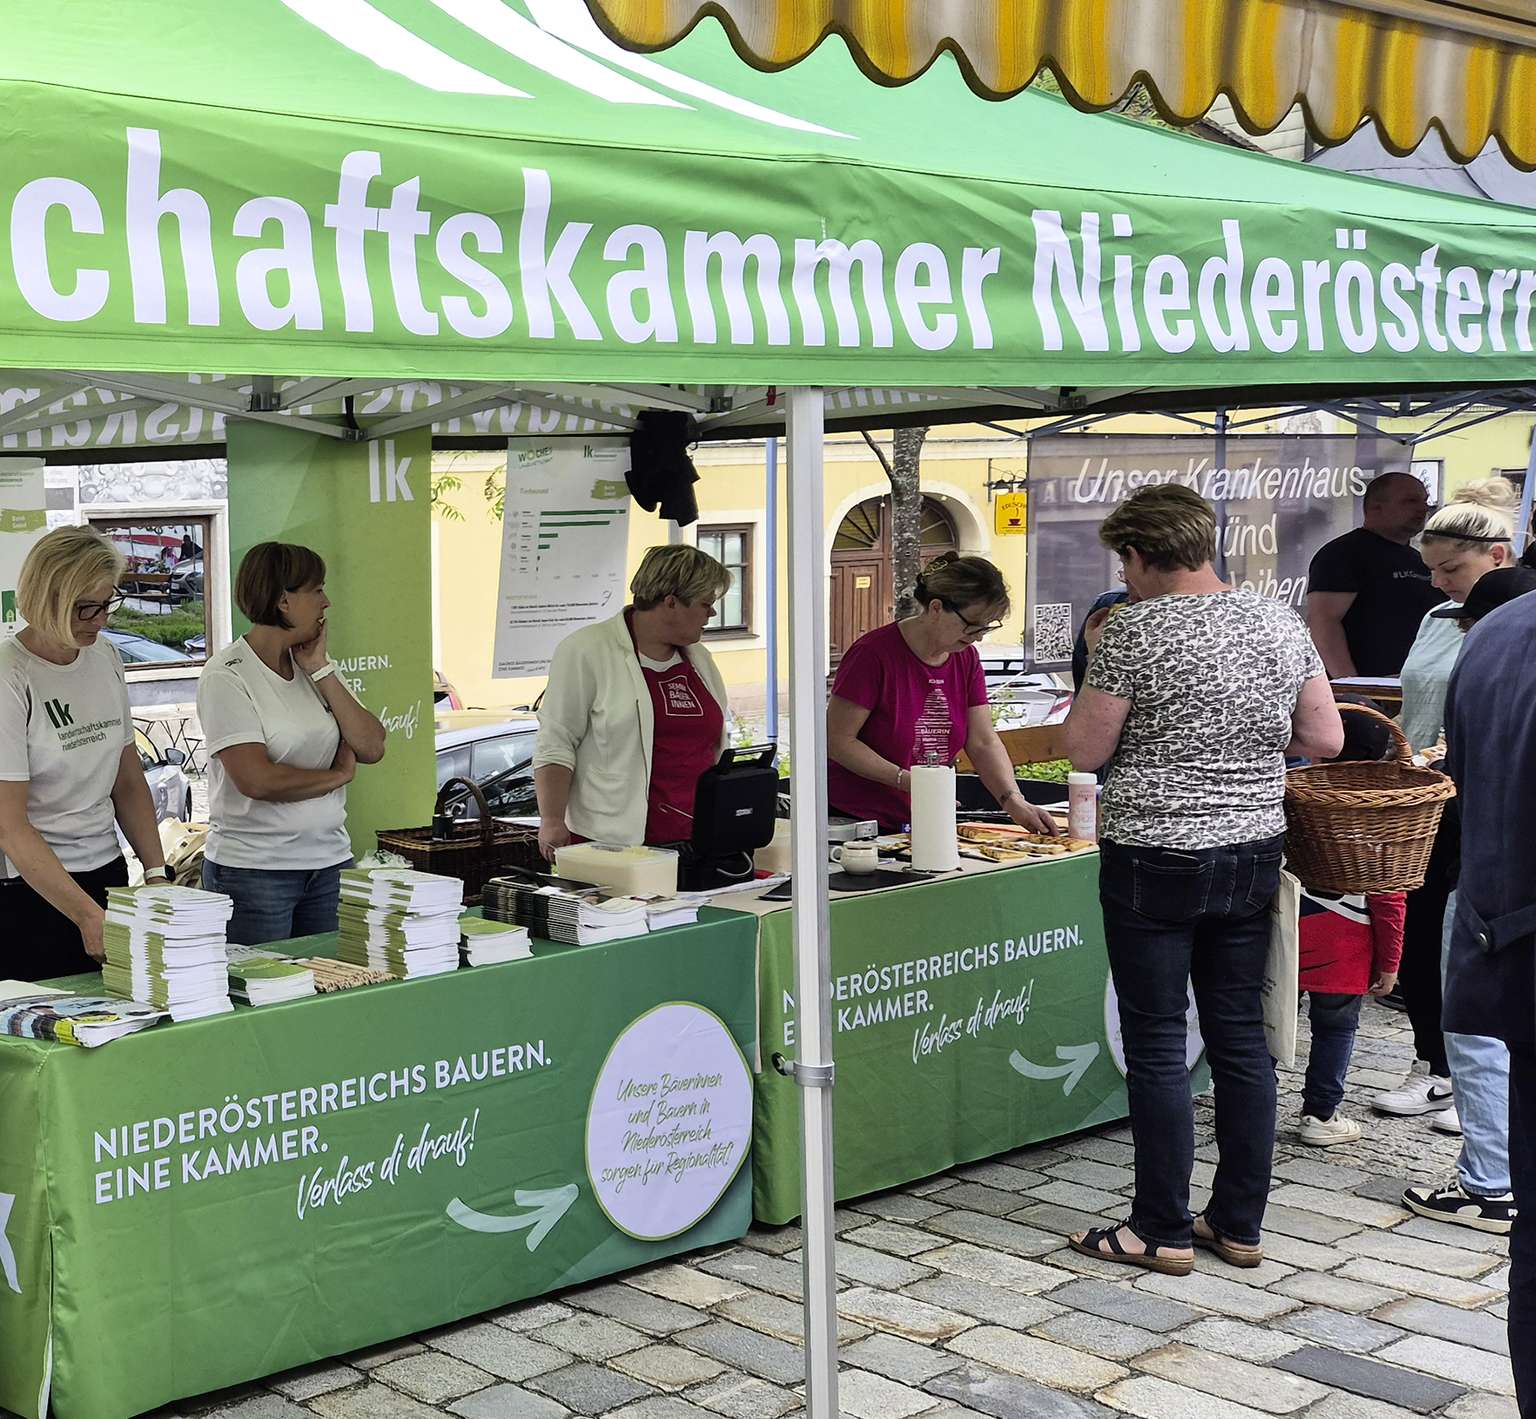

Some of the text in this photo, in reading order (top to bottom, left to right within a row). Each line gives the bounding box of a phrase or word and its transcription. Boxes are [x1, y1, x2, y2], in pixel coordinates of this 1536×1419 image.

[369, 440, 414, 504] lk
[1074, 457, 1177, 503] Unser
[1182, 456, 1367, 501] Krankenhaus
[44, 698, 74, 729] lk
[1004, 924, 1084, 963] BAUERN.
[838, 989, 934, 1033] KAMMER.
[913, 978, 1035, 1064] Verlass di drauf!
[93, 1039, 553, 1164] NIEDERÖSTERREICHS BAUERN.
[617, 1079, 658, 1101] Unsere
[628, 1098, 711, 1127] und Bauern in
[94, 1125, 330, 1205] EINE KAMMER.
[296, 1108, 481, 1222] Verlass di drauf!
[601, 1163, 642, 1194] sorgen
